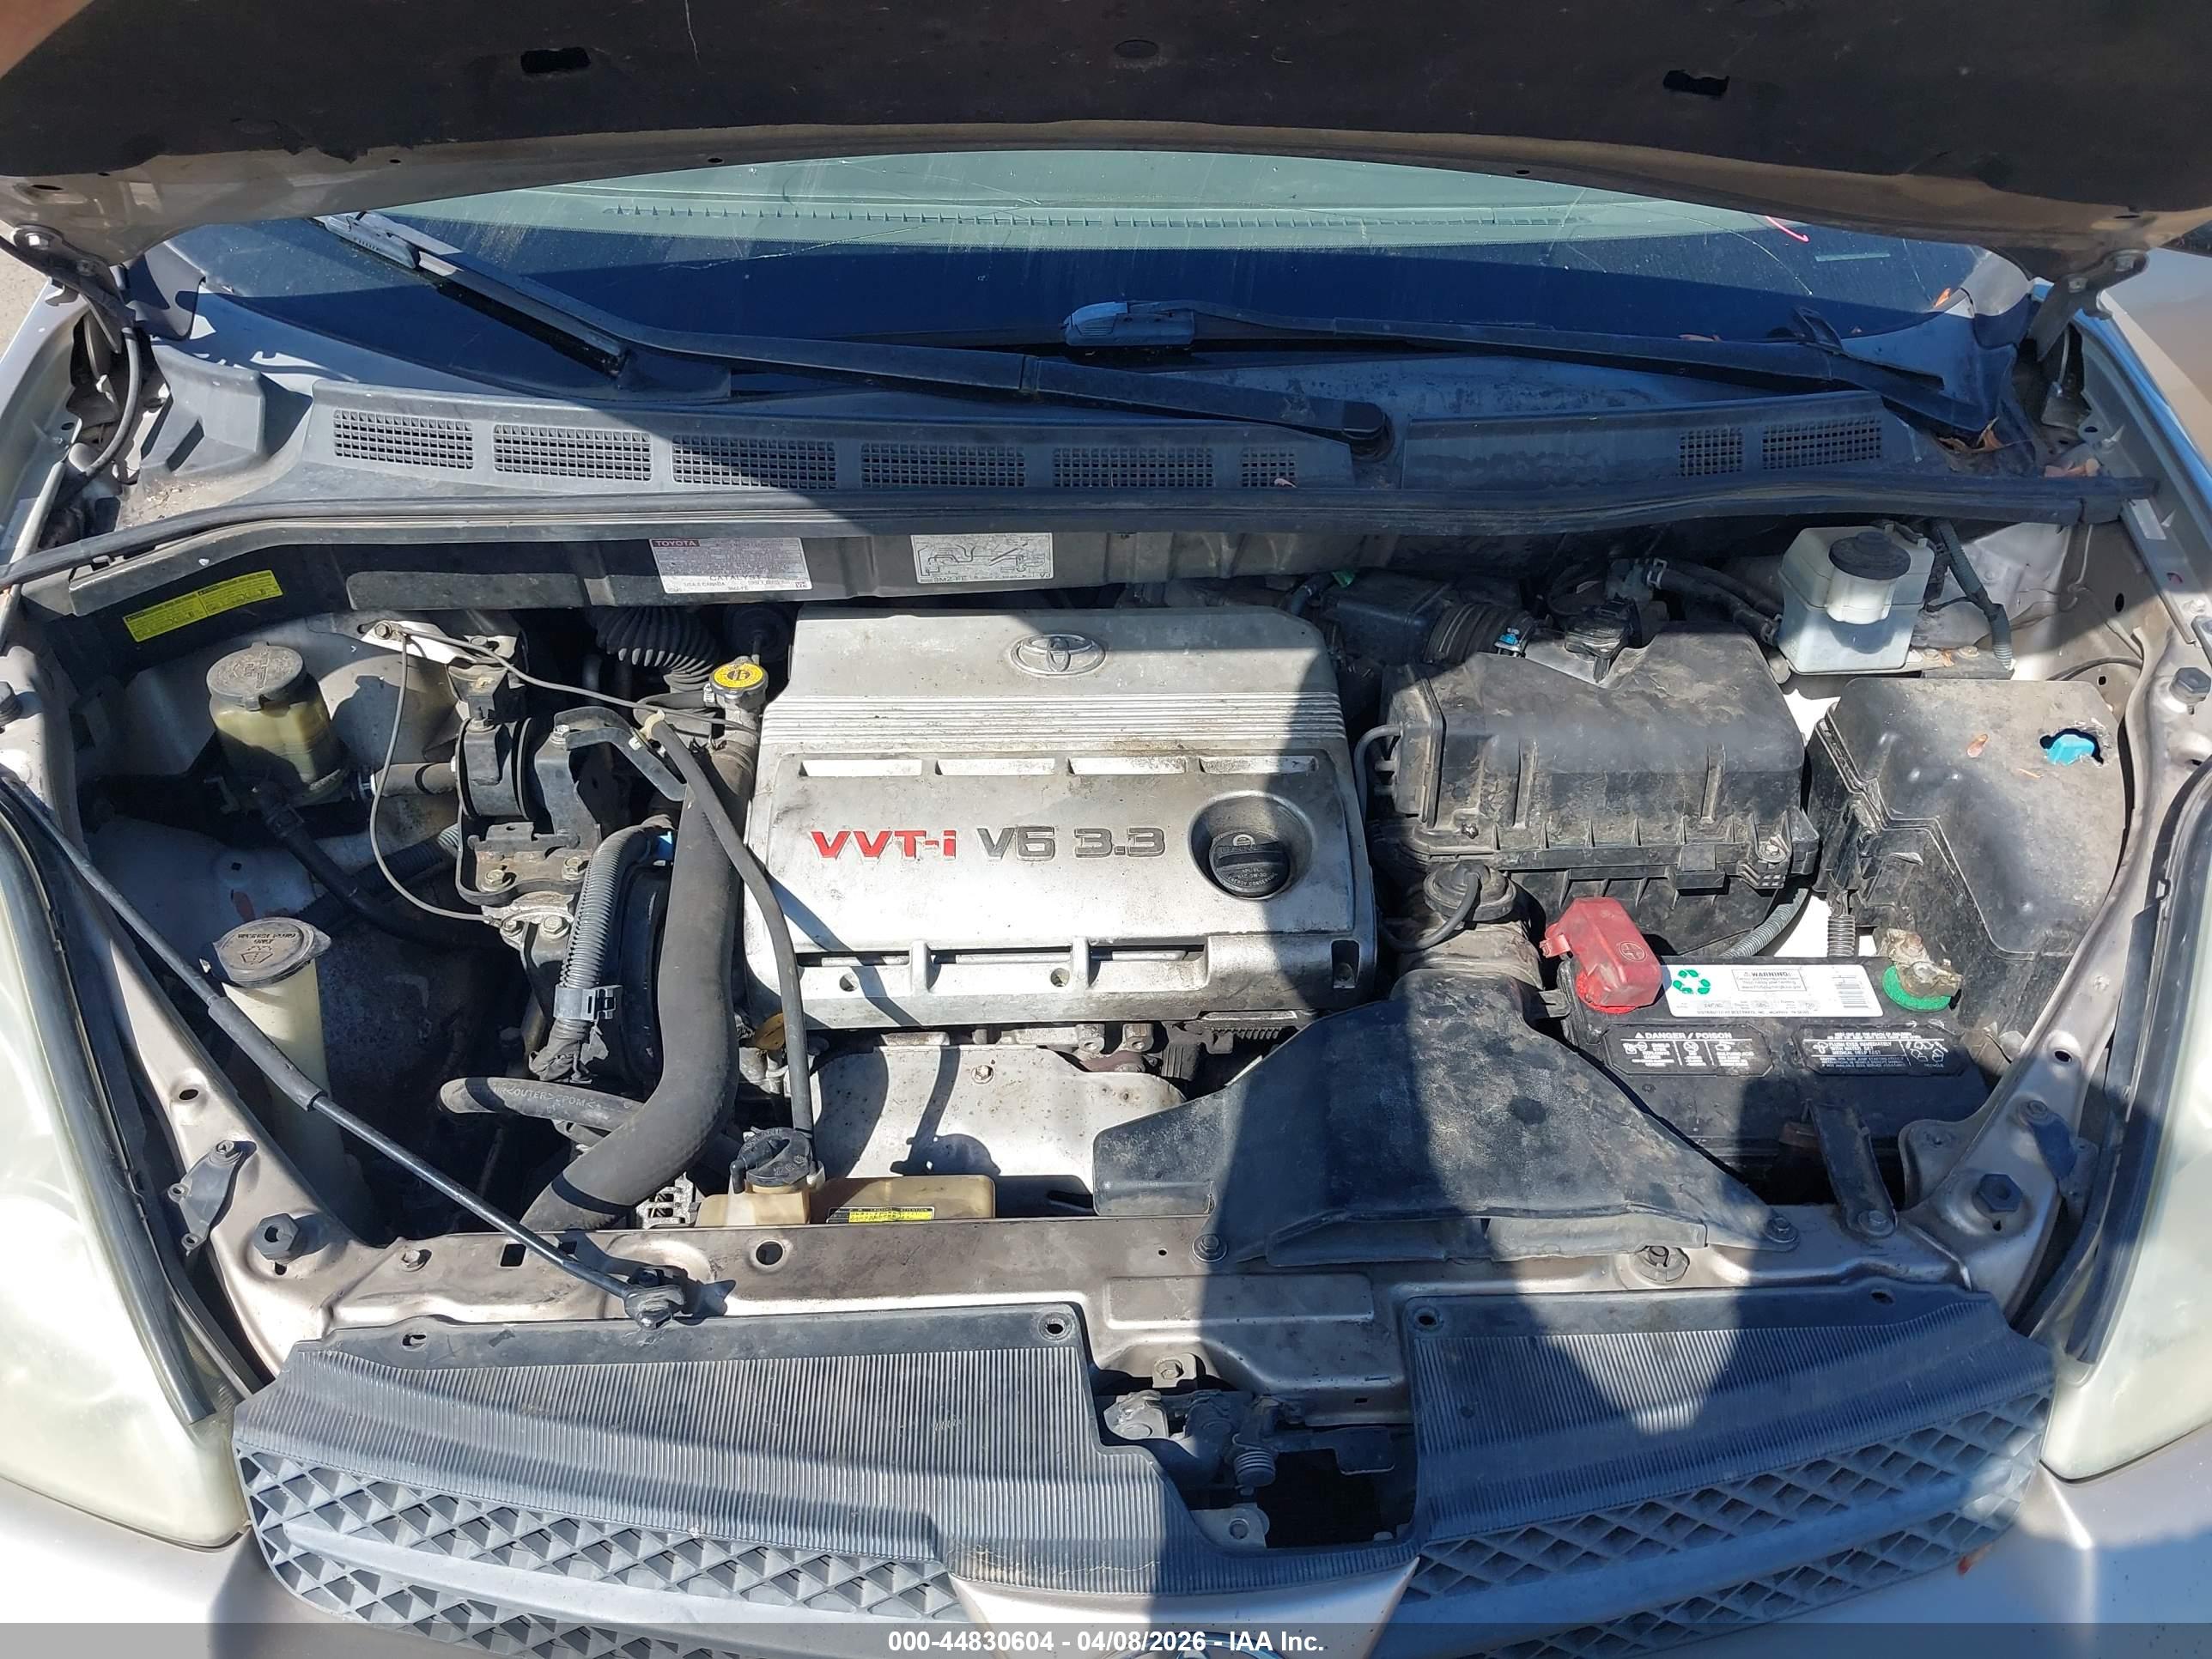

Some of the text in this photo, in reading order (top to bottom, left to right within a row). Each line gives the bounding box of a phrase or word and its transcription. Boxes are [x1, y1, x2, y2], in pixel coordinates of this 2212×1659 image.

[811, 826, 1166, 861] VVT-i V6 3.3
